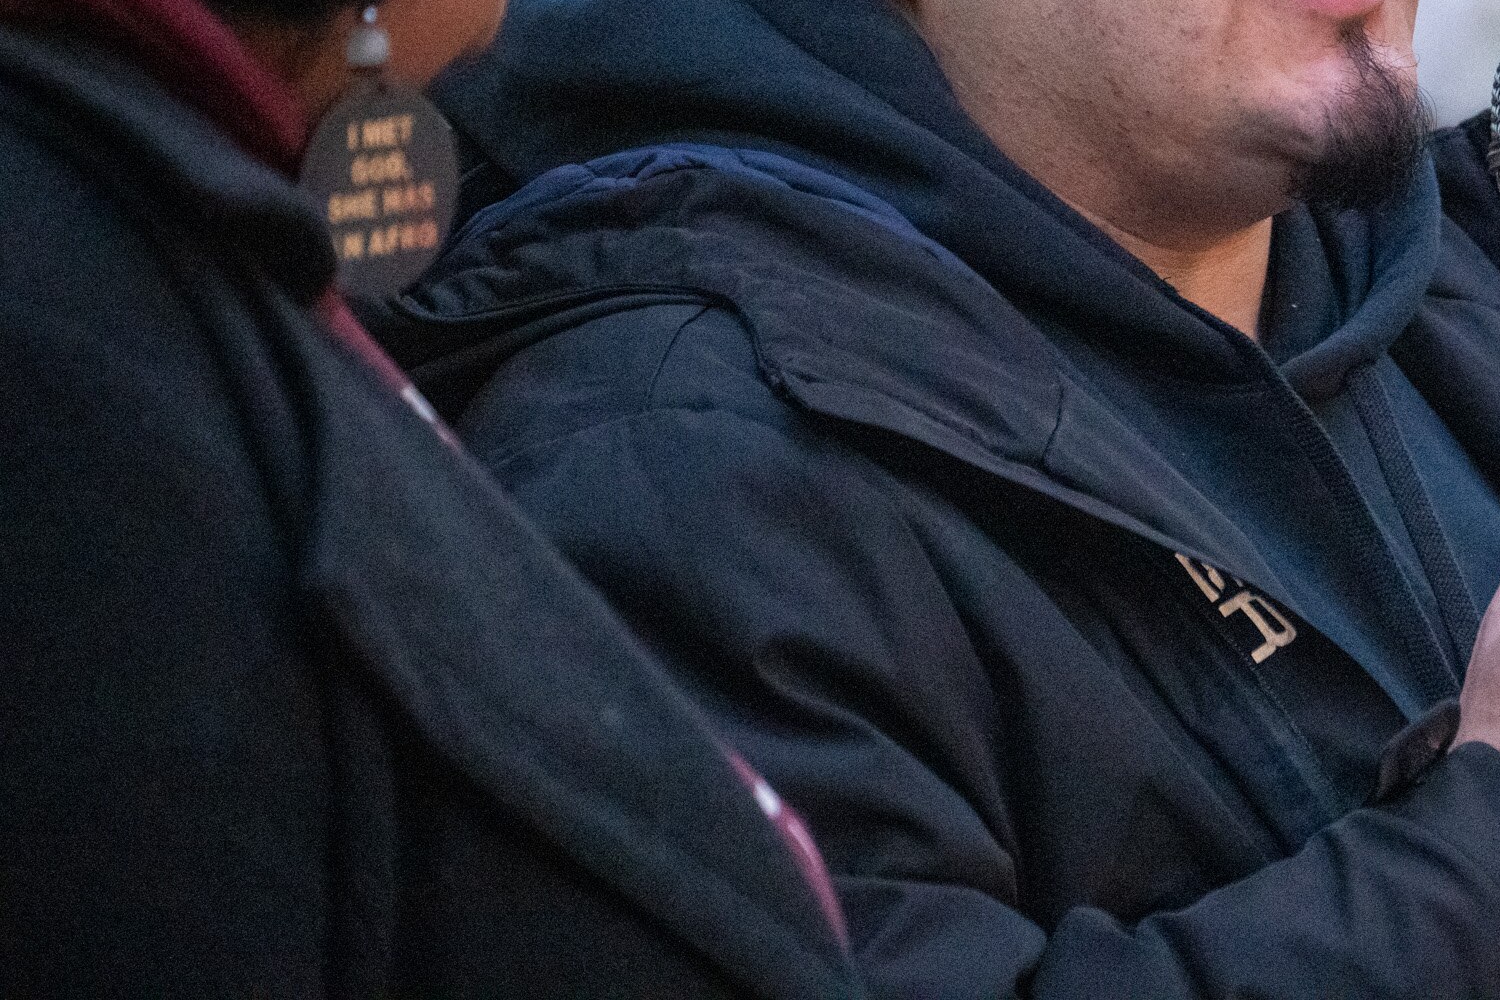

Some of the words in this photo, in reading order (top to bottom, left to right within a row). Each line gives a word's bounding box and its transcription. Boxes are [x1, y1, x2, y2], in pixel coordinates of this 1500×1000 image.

[347, 122, 358, 150] I
[363, 115, 412, 146] MET
[328, 190, 377, 223] SHE
